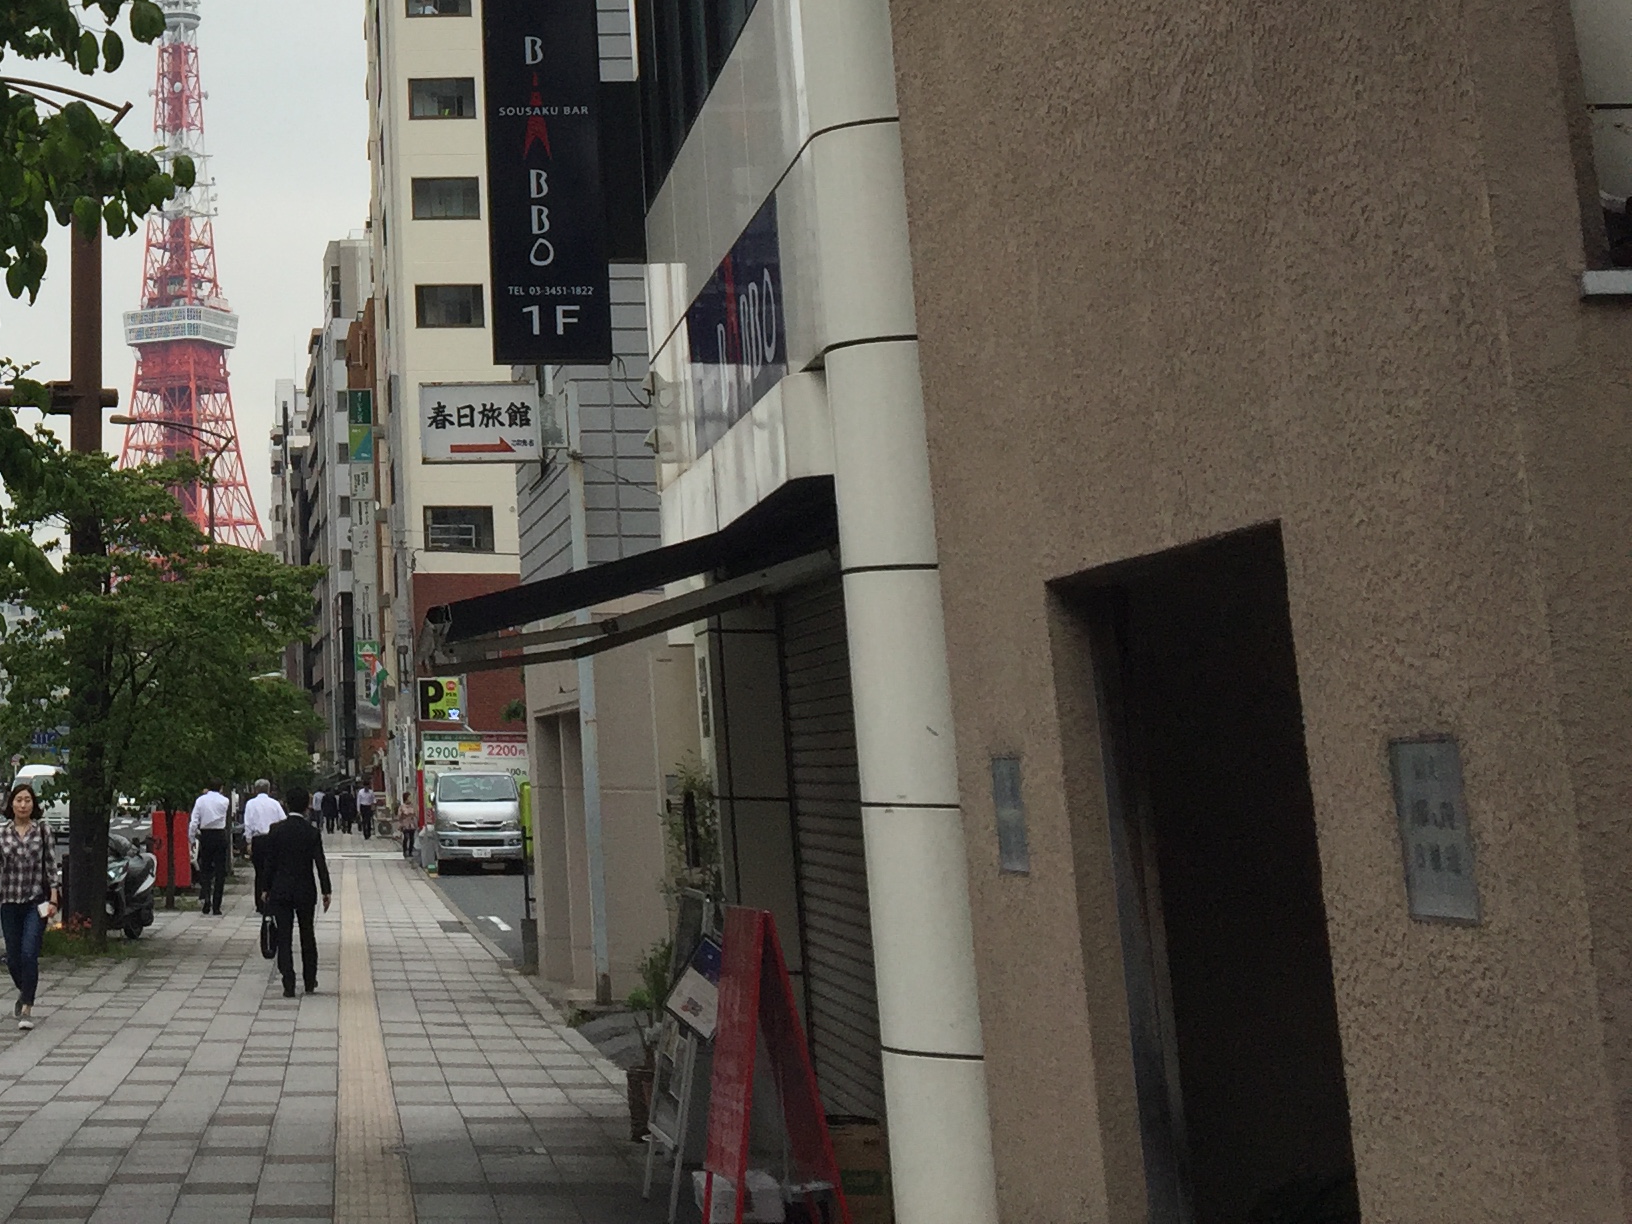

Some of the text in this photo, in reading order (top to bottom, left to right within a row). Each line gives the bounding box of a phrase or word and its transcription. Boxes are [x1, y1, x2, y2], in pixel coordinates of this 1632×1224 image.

[498, 105, 589, 116] SOUSAKU BAR
[508, 286, 594, 295] TEL 03-3451-1822
[521, 305, 581, 336] 1F
[427, 401, 532, 430] 春日旅館
[420, 680, 444, 720] P
